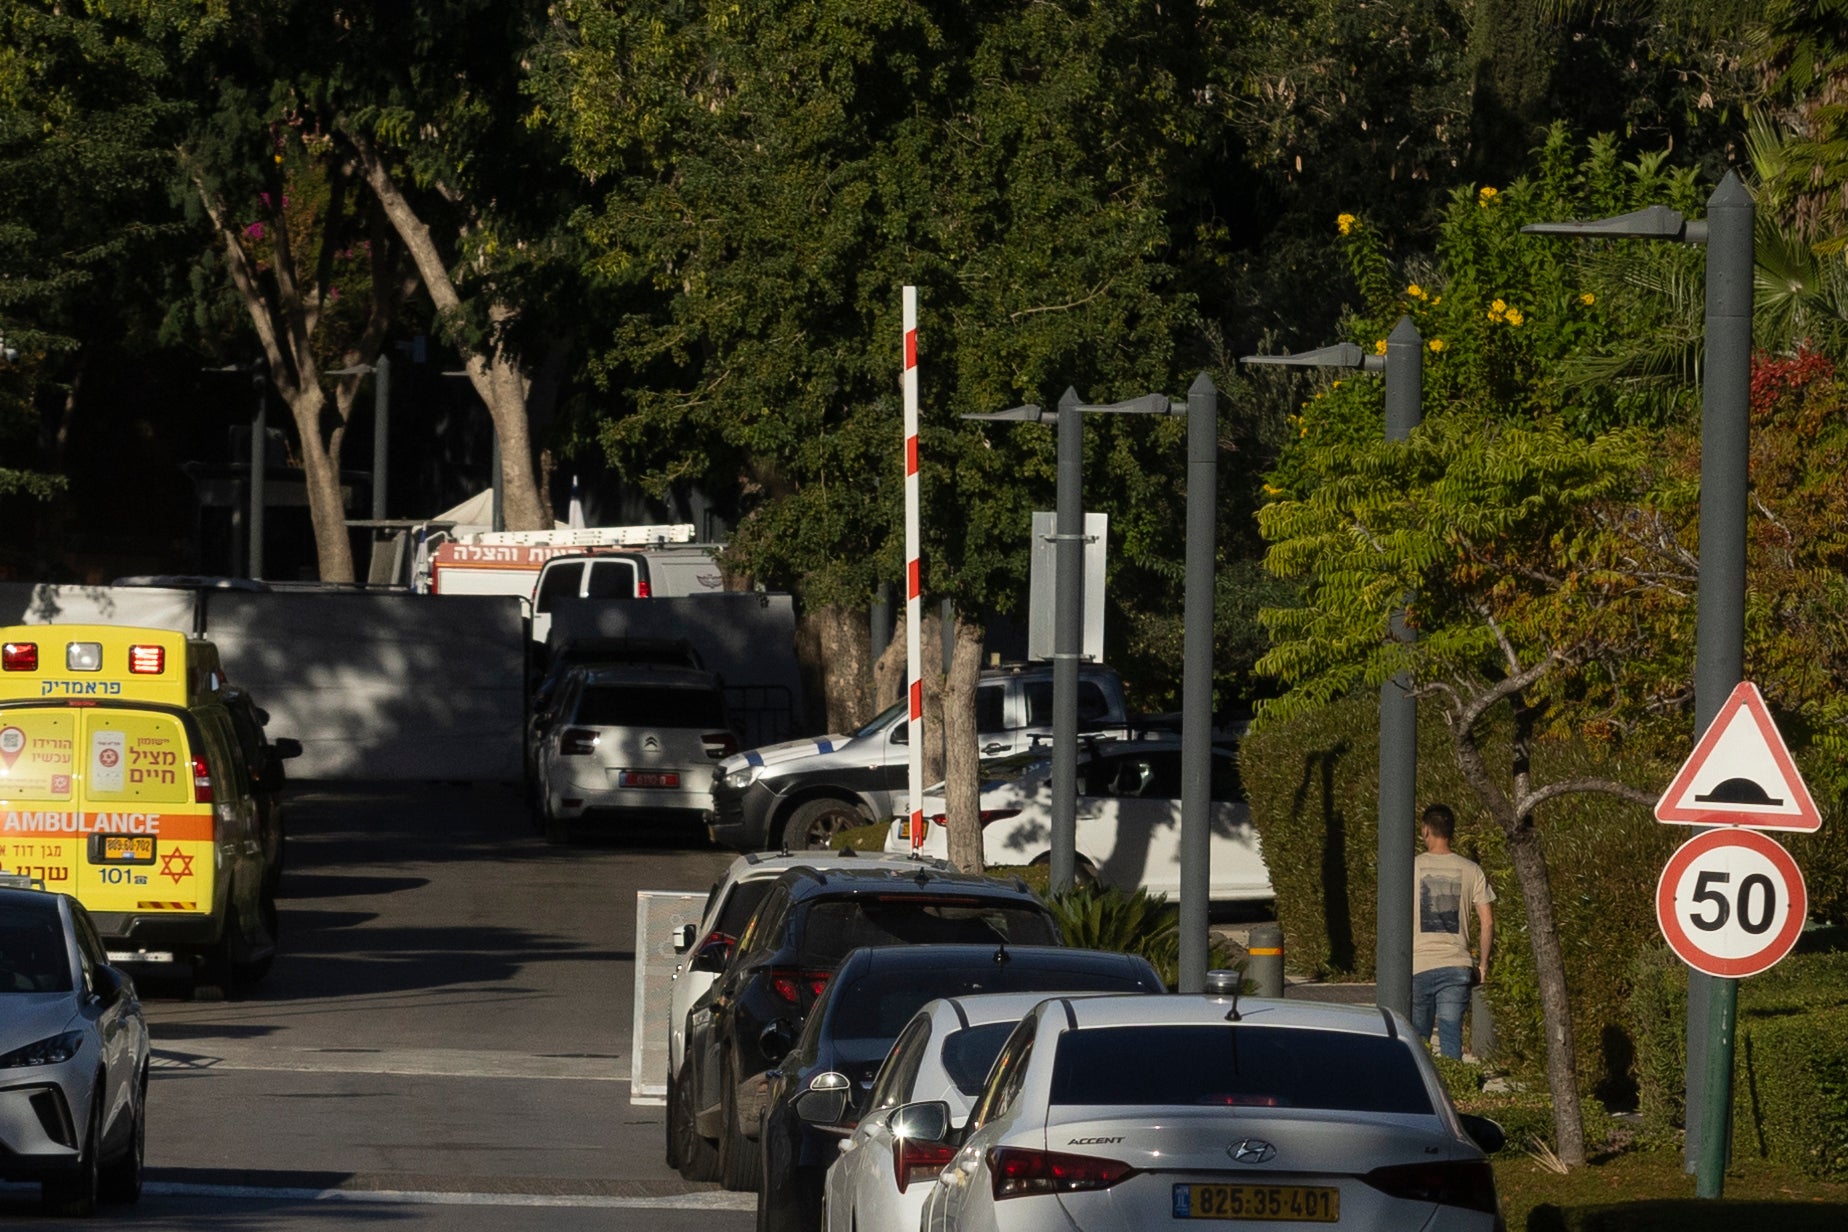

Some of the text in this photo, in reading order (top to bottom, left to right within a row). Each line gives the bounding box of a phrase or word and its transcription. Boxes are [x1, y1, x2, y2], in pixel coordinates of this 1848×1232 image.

[453, 546, 518, 560] והצלה
[42, 680, 121, 695] פראמדיק
[32, 738, 72, 749] הורידו
[32, 752, 71, 763] עכשיו
[129, 746, 176, 766] מציל
[129, 768, 175, 784] חיים
[3, 811, 160, 834] AMBULANCE
[13, 845, 34, 856] דוד
[41, 845, 62, 859] מגן
[98, 868, 133, 884] 101
[1689, 870, 1777, 935] 50
[1067, 1136, 1126, 1146] ACCENT
